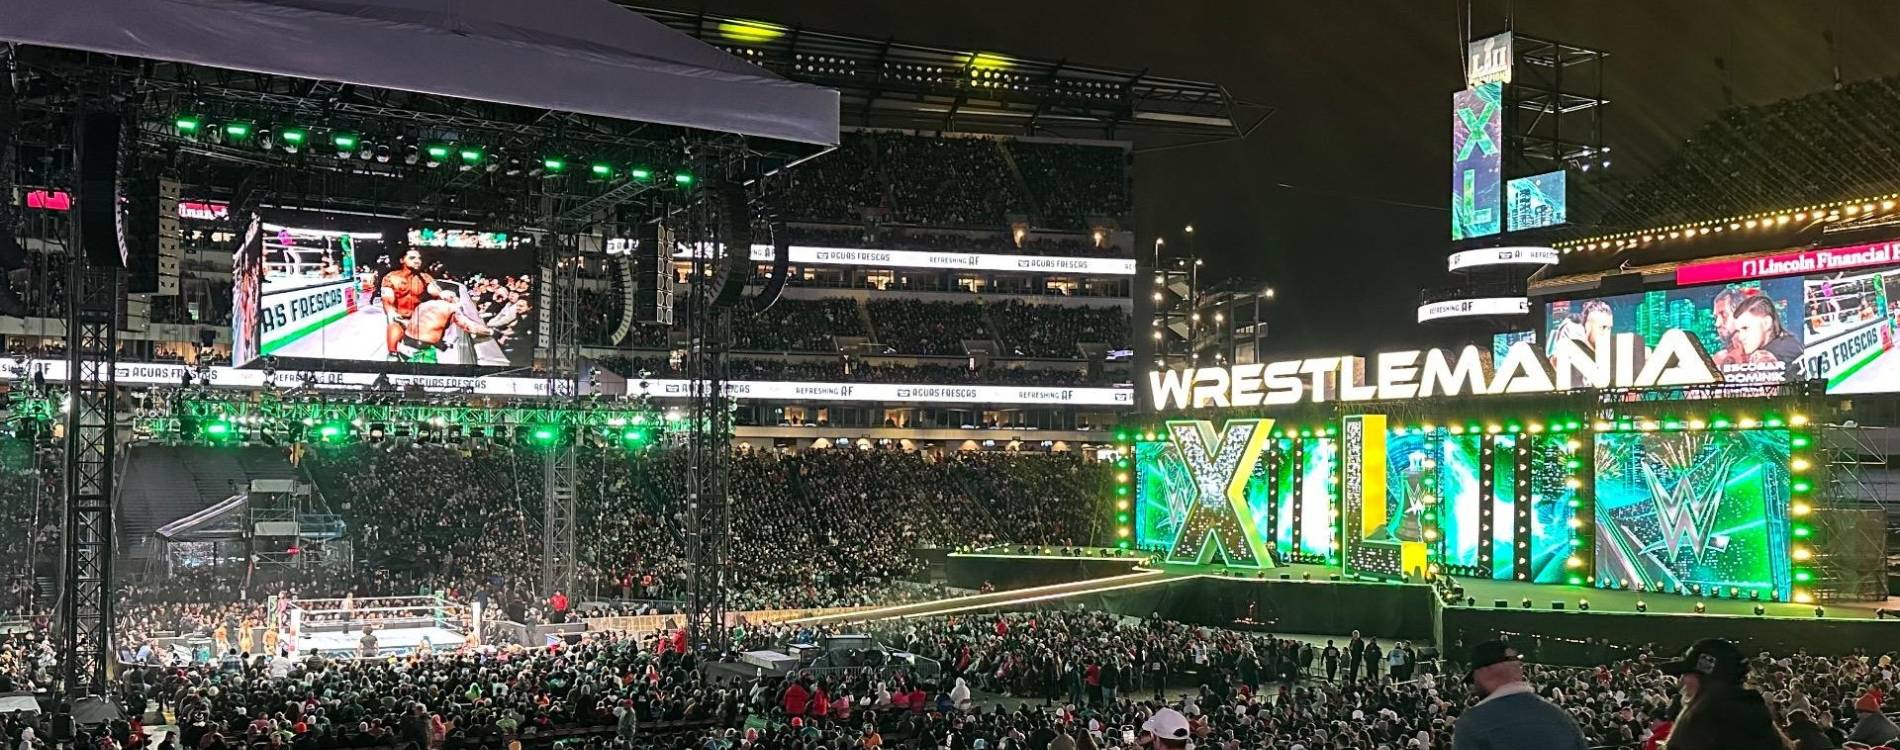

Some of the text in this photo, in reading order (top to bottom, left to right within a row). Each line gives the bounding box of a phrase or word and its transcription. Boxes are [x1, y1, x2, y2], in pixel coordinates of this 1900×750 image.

[1758, 254, 1814, 275] Lincoln
[1817, 245, 1892, 269] Financial
[291, 288, 342, 321] FRESCAS
[1832, 327, 1878, 366] FRESCAS
[1149, 327, 1718, 411] WRESTLEMANIA
[1725, 372, 1786, 382] DOMINIK
[795, 386, 854, 397] REFRESHING AF
[1061, 390, 1074, 401] AF
